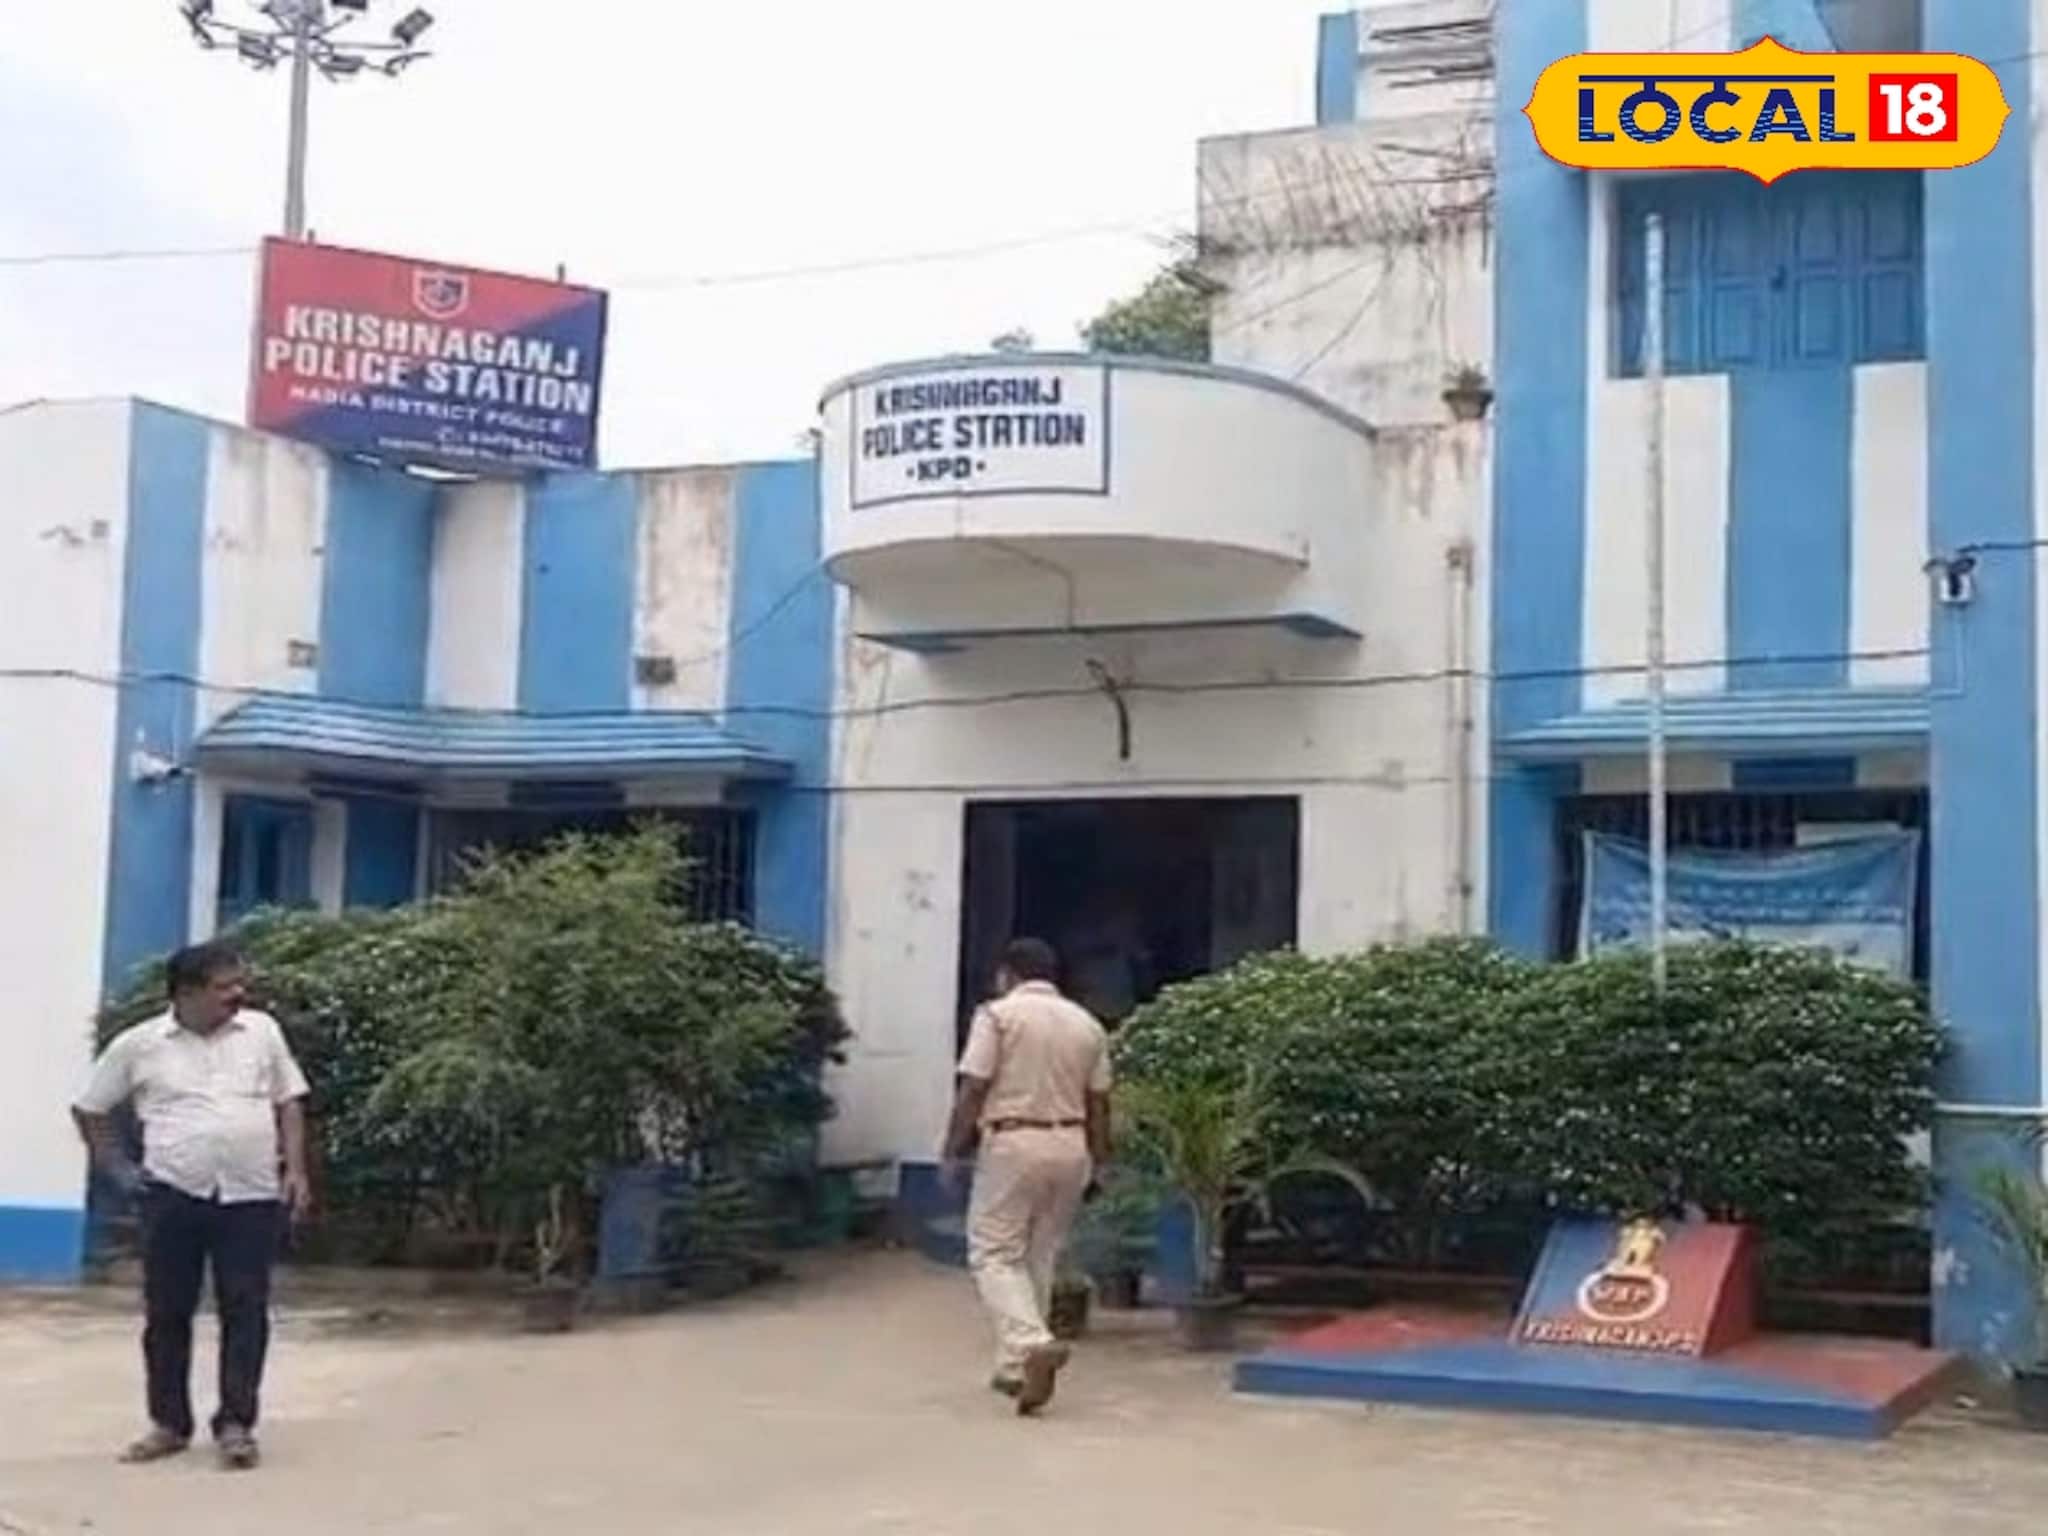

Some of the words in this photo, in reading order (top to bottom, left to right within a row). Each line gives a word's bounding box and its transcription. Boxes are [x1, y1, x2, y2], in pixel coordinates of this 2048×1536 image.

[285, 305, 579, 378] KRISHNAGANJ
[264, 337, 411, 389] POLICE
[423, 360, 592, 415] STATION
[875, 376, 1062, 417] KRISHNAGANJ
[371, 394, 478, 421] DISTRICT
[484, 410, 563, 434] POLICE
[863, 418, 944, 460] POLICE
[953, 413, 1085, 449] STATION
